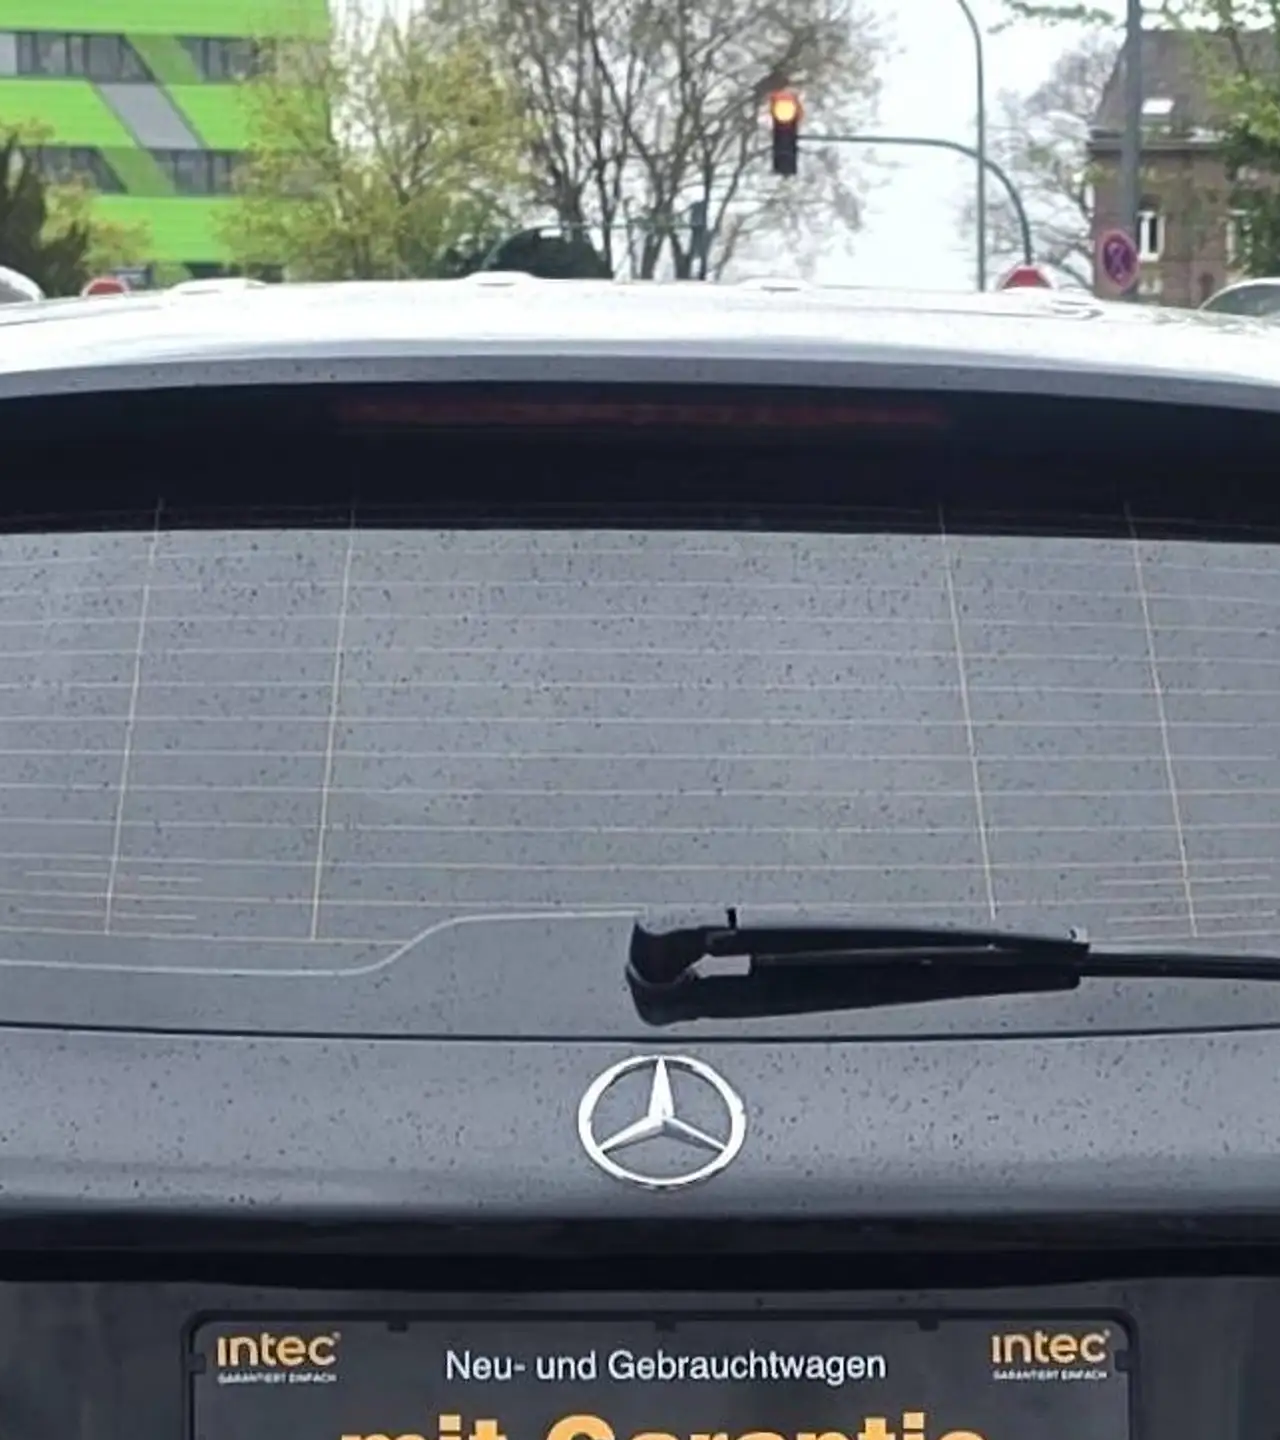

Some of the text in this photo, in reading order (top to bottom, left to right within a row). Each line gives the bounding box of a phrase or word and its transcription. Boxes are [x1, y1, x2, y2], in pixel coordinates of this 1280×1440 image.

[445, 1348, 886, 1386] Neu- und Gebrauchtwagen
